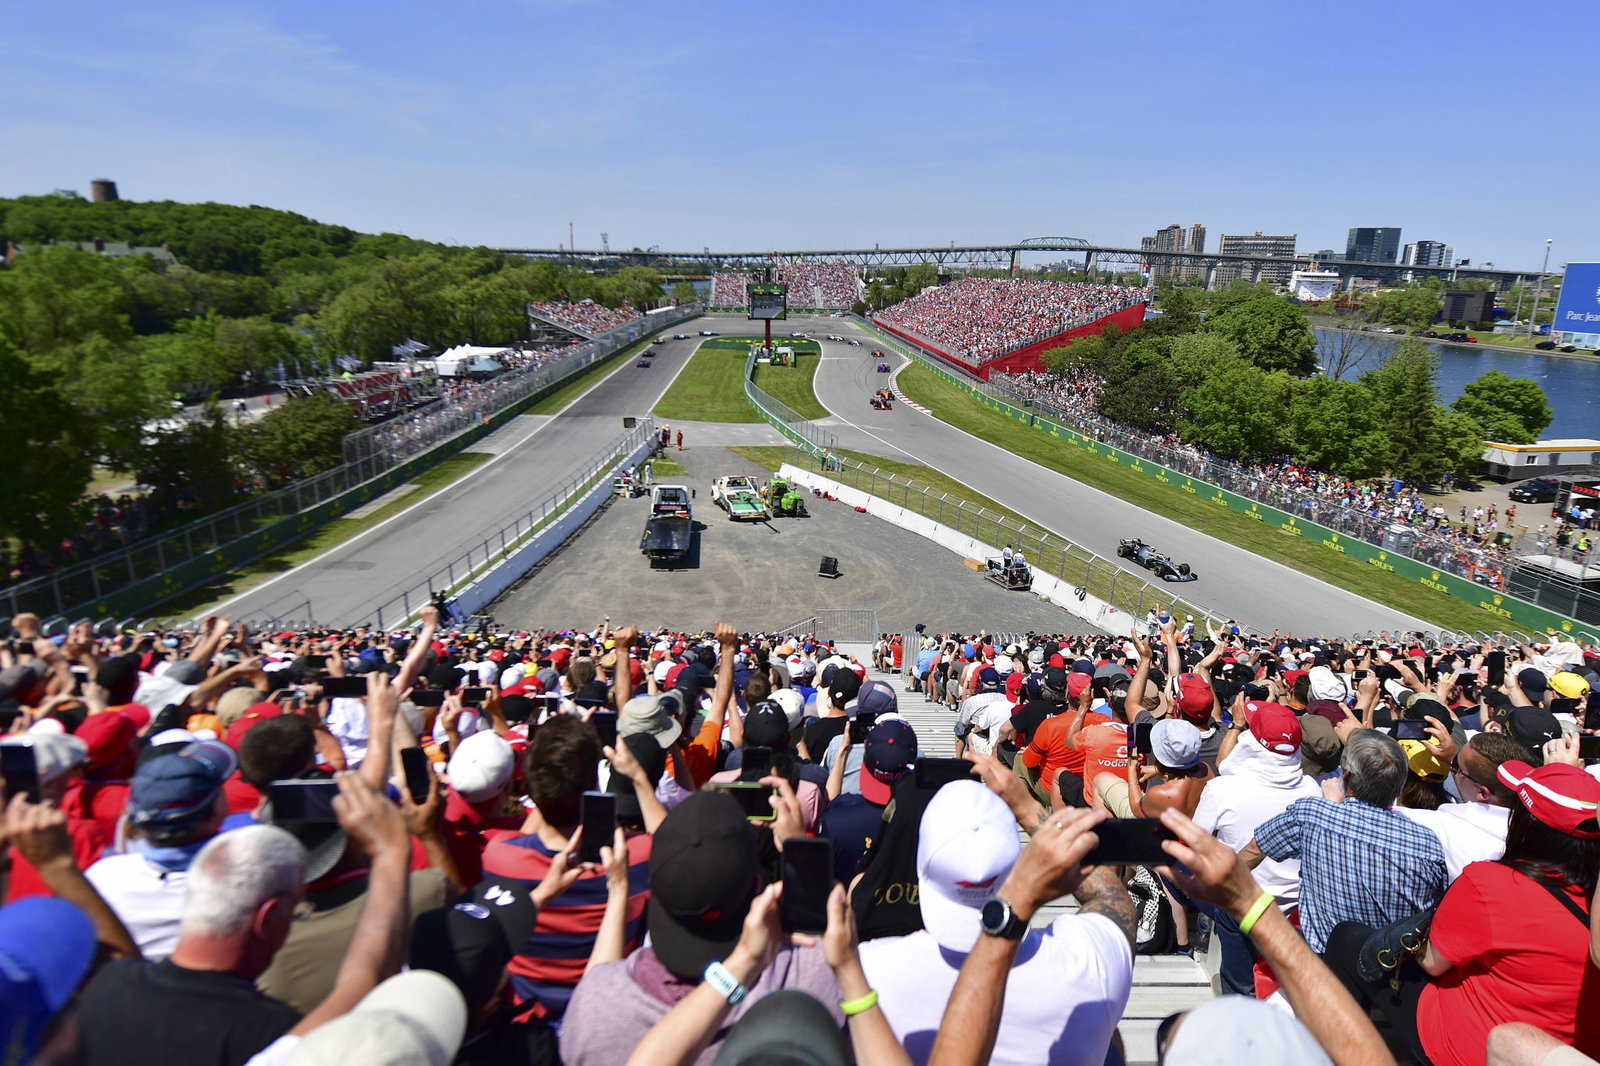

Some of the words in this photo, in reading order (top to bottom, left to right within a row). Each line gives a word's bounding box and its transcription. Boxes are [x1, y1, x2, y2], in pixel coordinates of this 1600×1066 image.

[1567, 310, 1584, 320] Parc
[1181, 484, 1196, 494] ROLEX
[1211, 496, 1228, 506] ROLEX
[1244, 509, 1263, 520] ROLEX
[1281, 523, 1302, 535] ROLEX
[1323, 539, 1345, 553] ROLEX
[1368, 557, 1395, 572] ROLEX
[1420, 577, 1449, 593] ROLEX
[1479, 601, 1513, 619] ROLEX
[1097, 758, 1129, 768] vodaf
[1520, 788, 1533, 808] VETTEL
